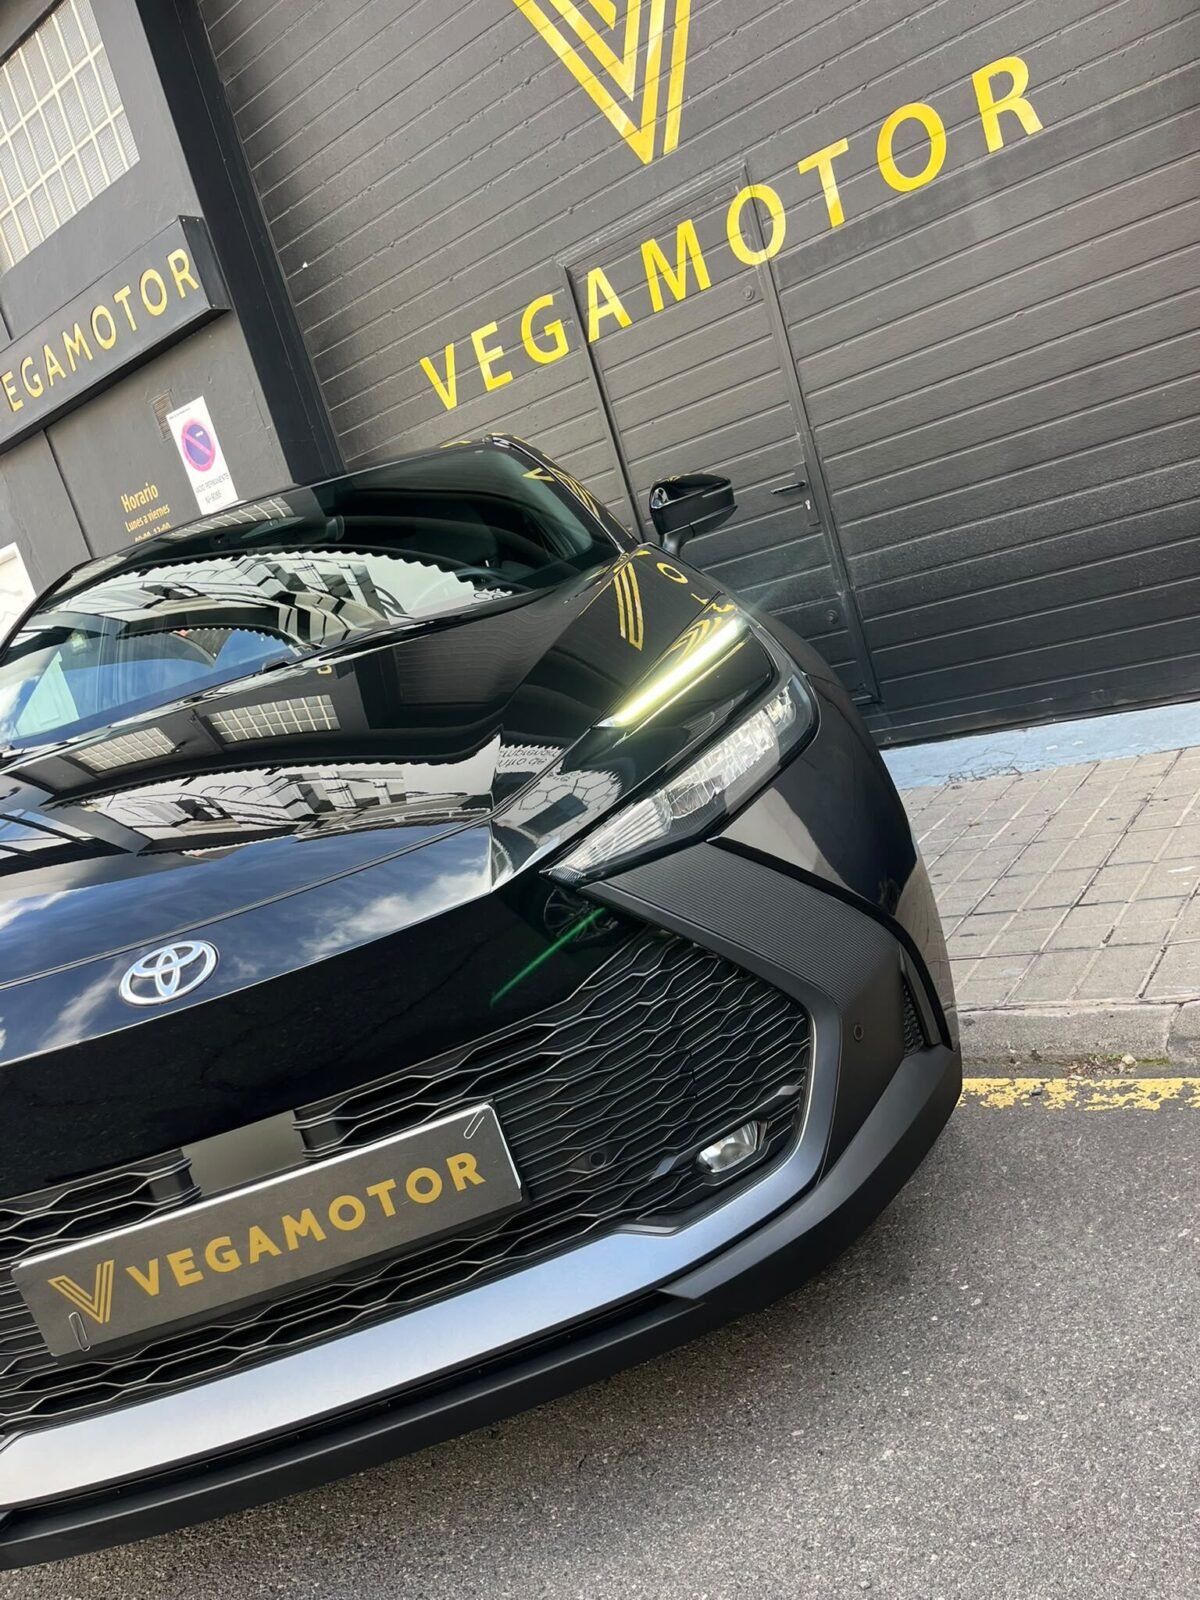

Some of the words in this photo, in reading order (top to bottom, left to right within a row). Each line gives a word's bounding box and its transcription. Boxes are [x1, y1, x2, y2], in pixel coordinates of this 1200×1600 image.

[419, 55, 1043, 411] VEGAMOTOR
[1, 248, 199, 413] EGAMOTOR
[120, 481, 159, 513] Horario
[125, 518, 145, 532] Lunes
[147, 504, 170, 521] viernes
[125, 1152, 486, 1297] VEGAMOTOR
